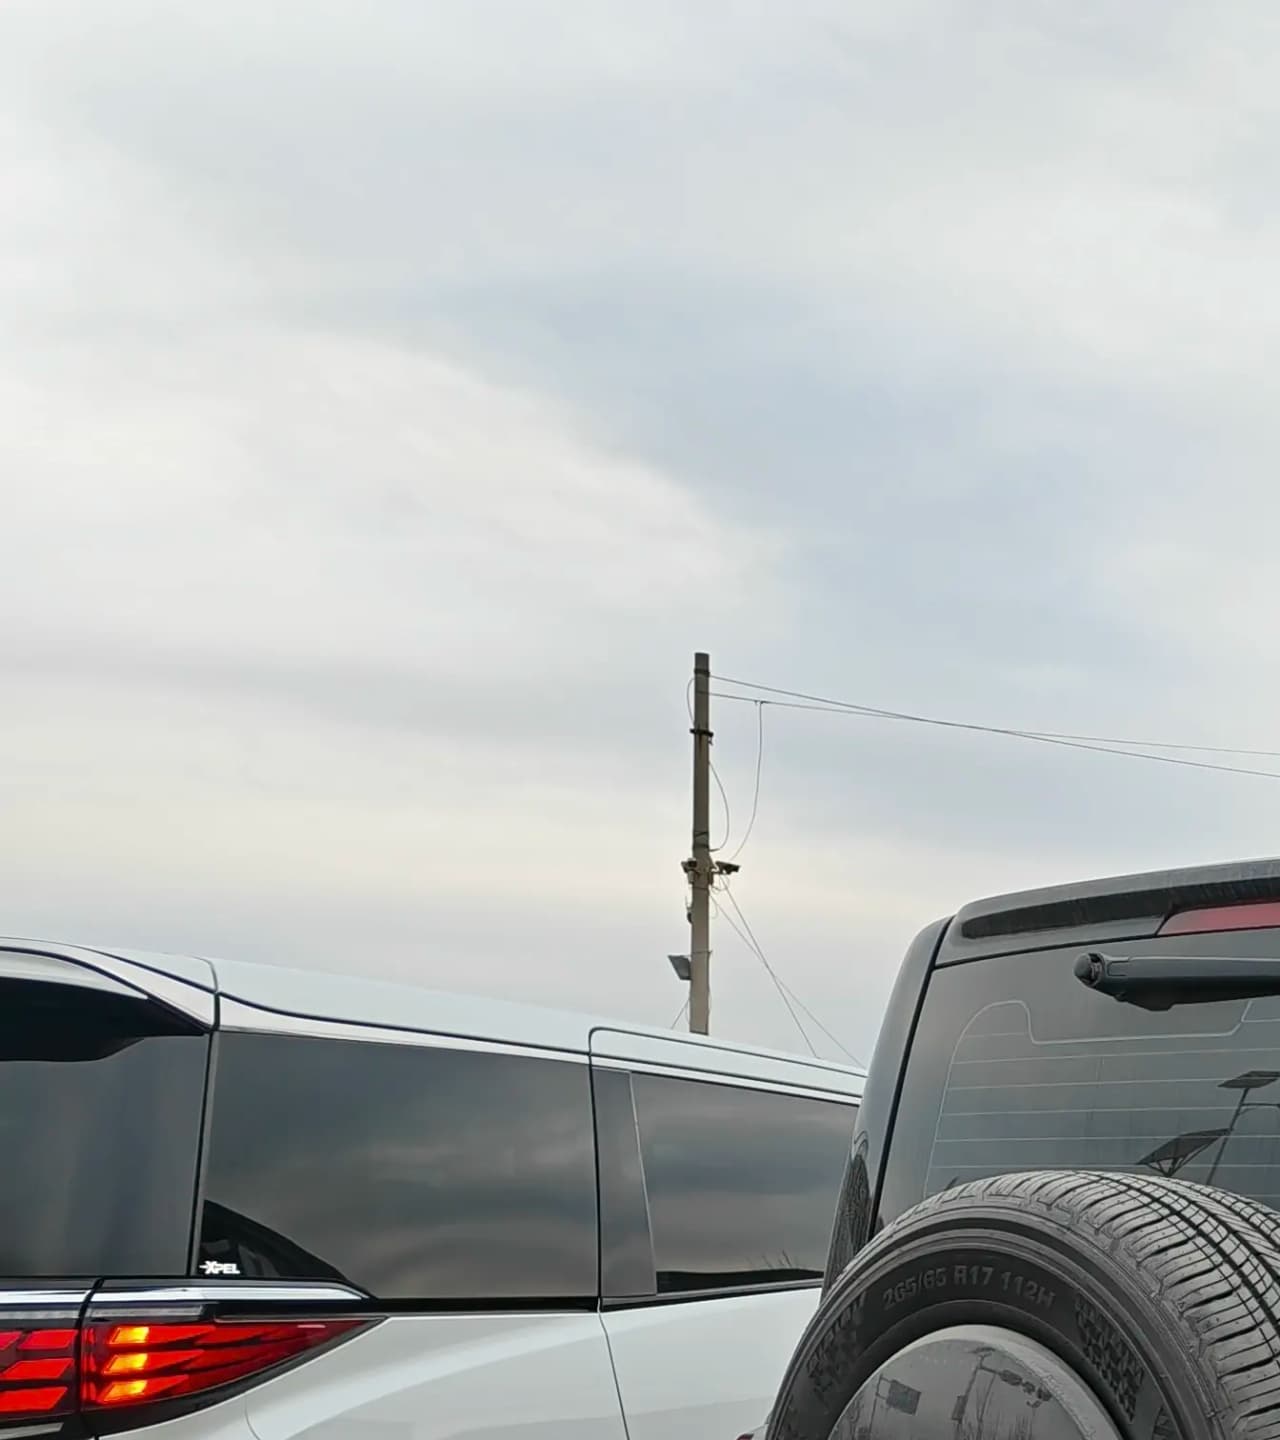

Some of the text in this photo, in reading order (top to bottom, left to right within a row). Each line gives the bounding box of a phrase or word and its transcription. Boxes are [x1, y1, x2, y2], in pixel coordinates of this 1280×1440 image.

[200, 1261, 241, 1275] XPEL
[882, 1264, 1056, 1310] 265/65 R17 112H
